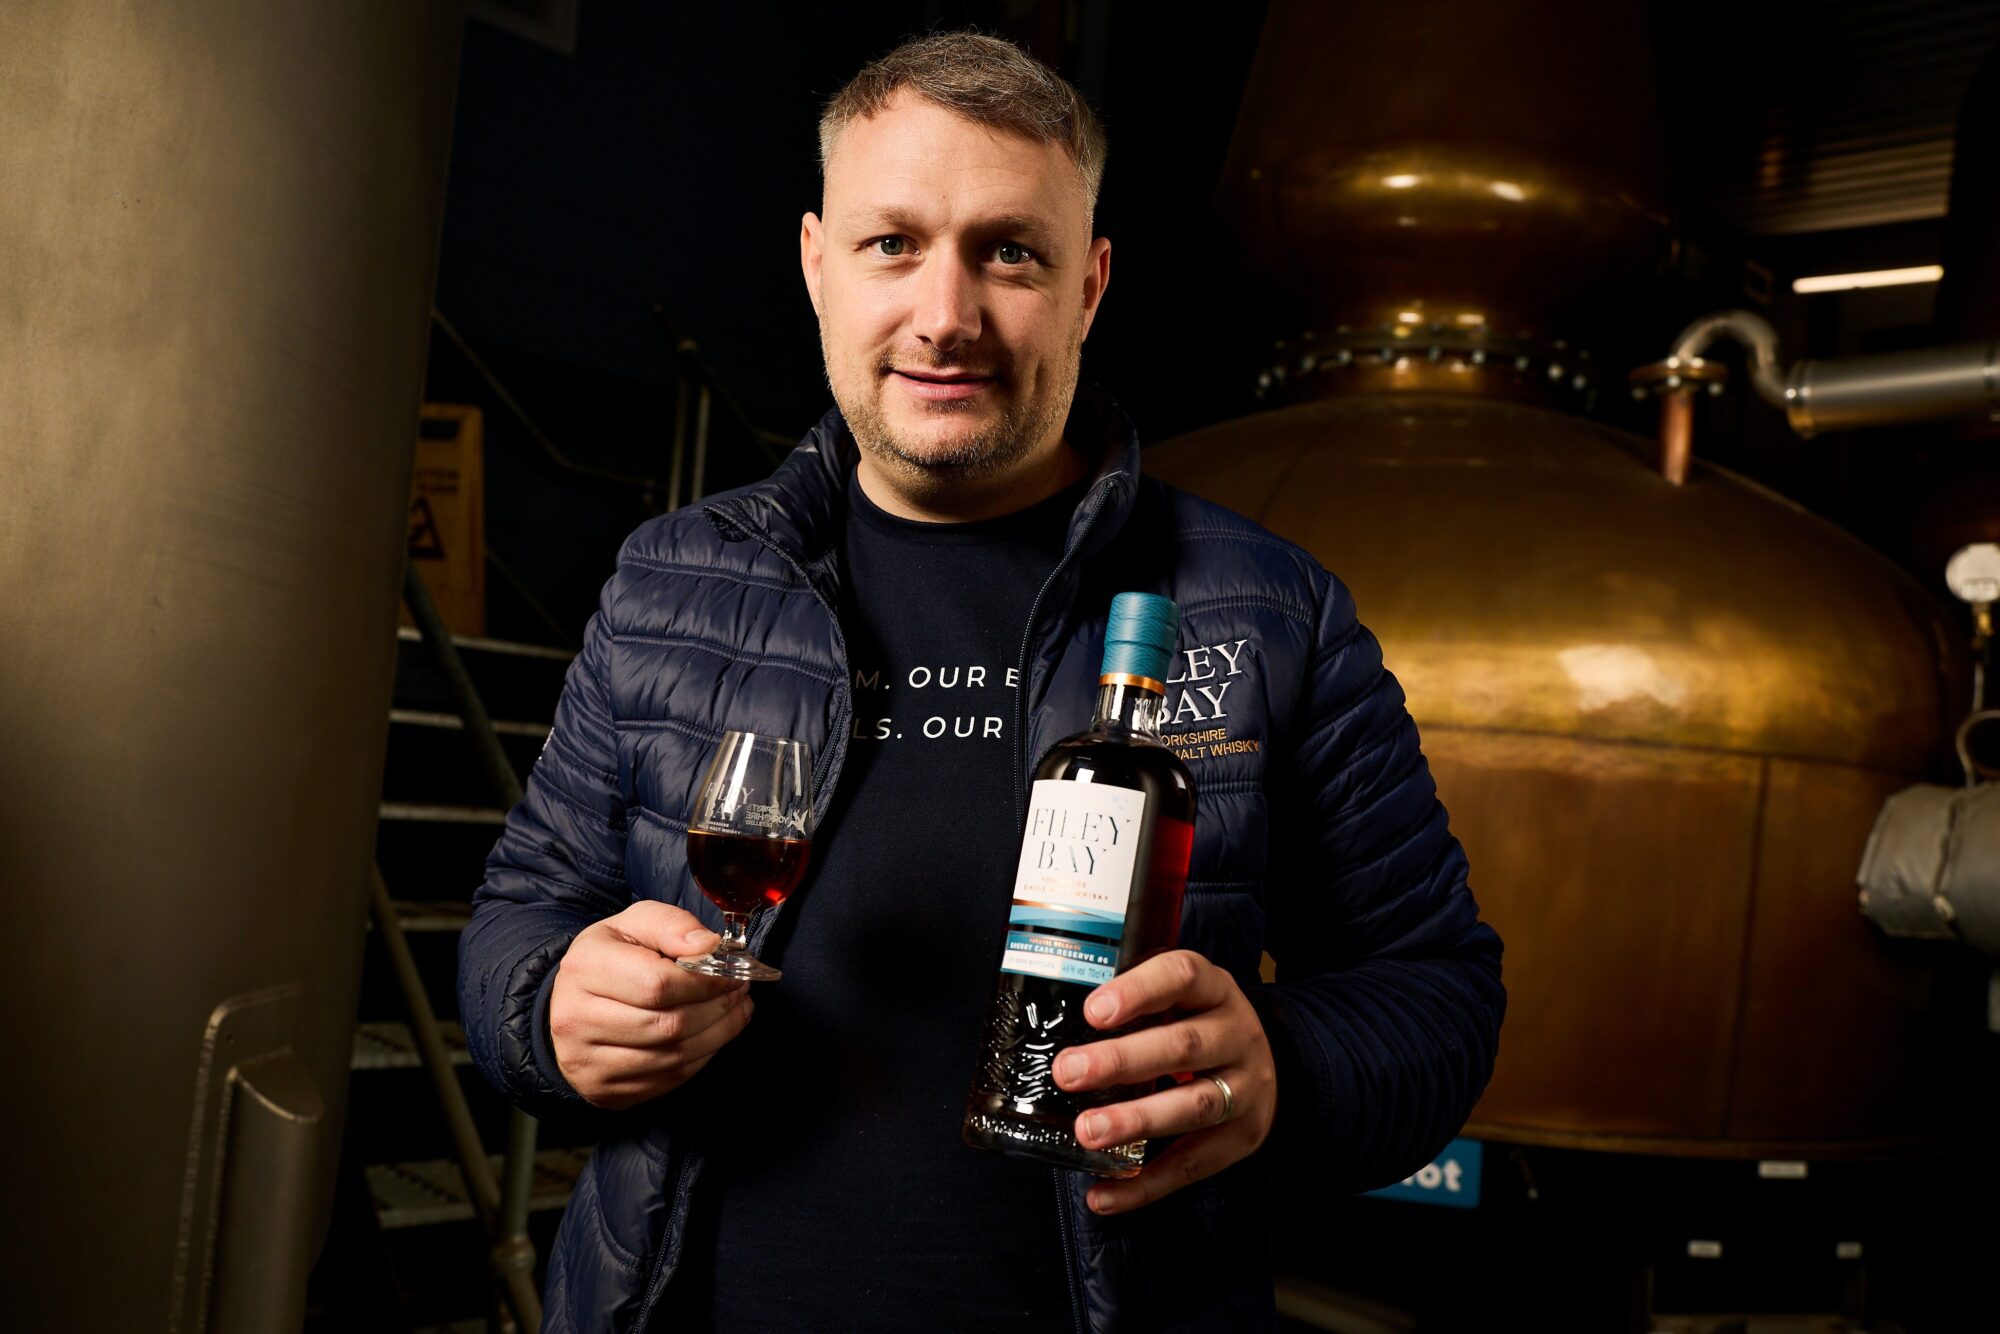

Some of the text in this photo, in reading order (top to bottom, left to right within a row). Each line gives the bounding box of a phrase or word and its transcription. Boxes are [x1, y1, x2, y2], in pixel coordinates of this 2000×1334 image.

[908, 666, 986, 689] OUR
[922, 716, 1003, 739] OUR
[1160, 728, 1227, 747] ORKSHIRE
[1210, 739, 1260, 757] WHISKY
[1032, 808, 1130, 845] FILEY
[1038, 841, 1106, 875] BAY
[1034, 944, 1055, 954] CASK
[1056, 948, 1095, 962] RESERVE
[1401, 1161, 1461, 1192] ot
